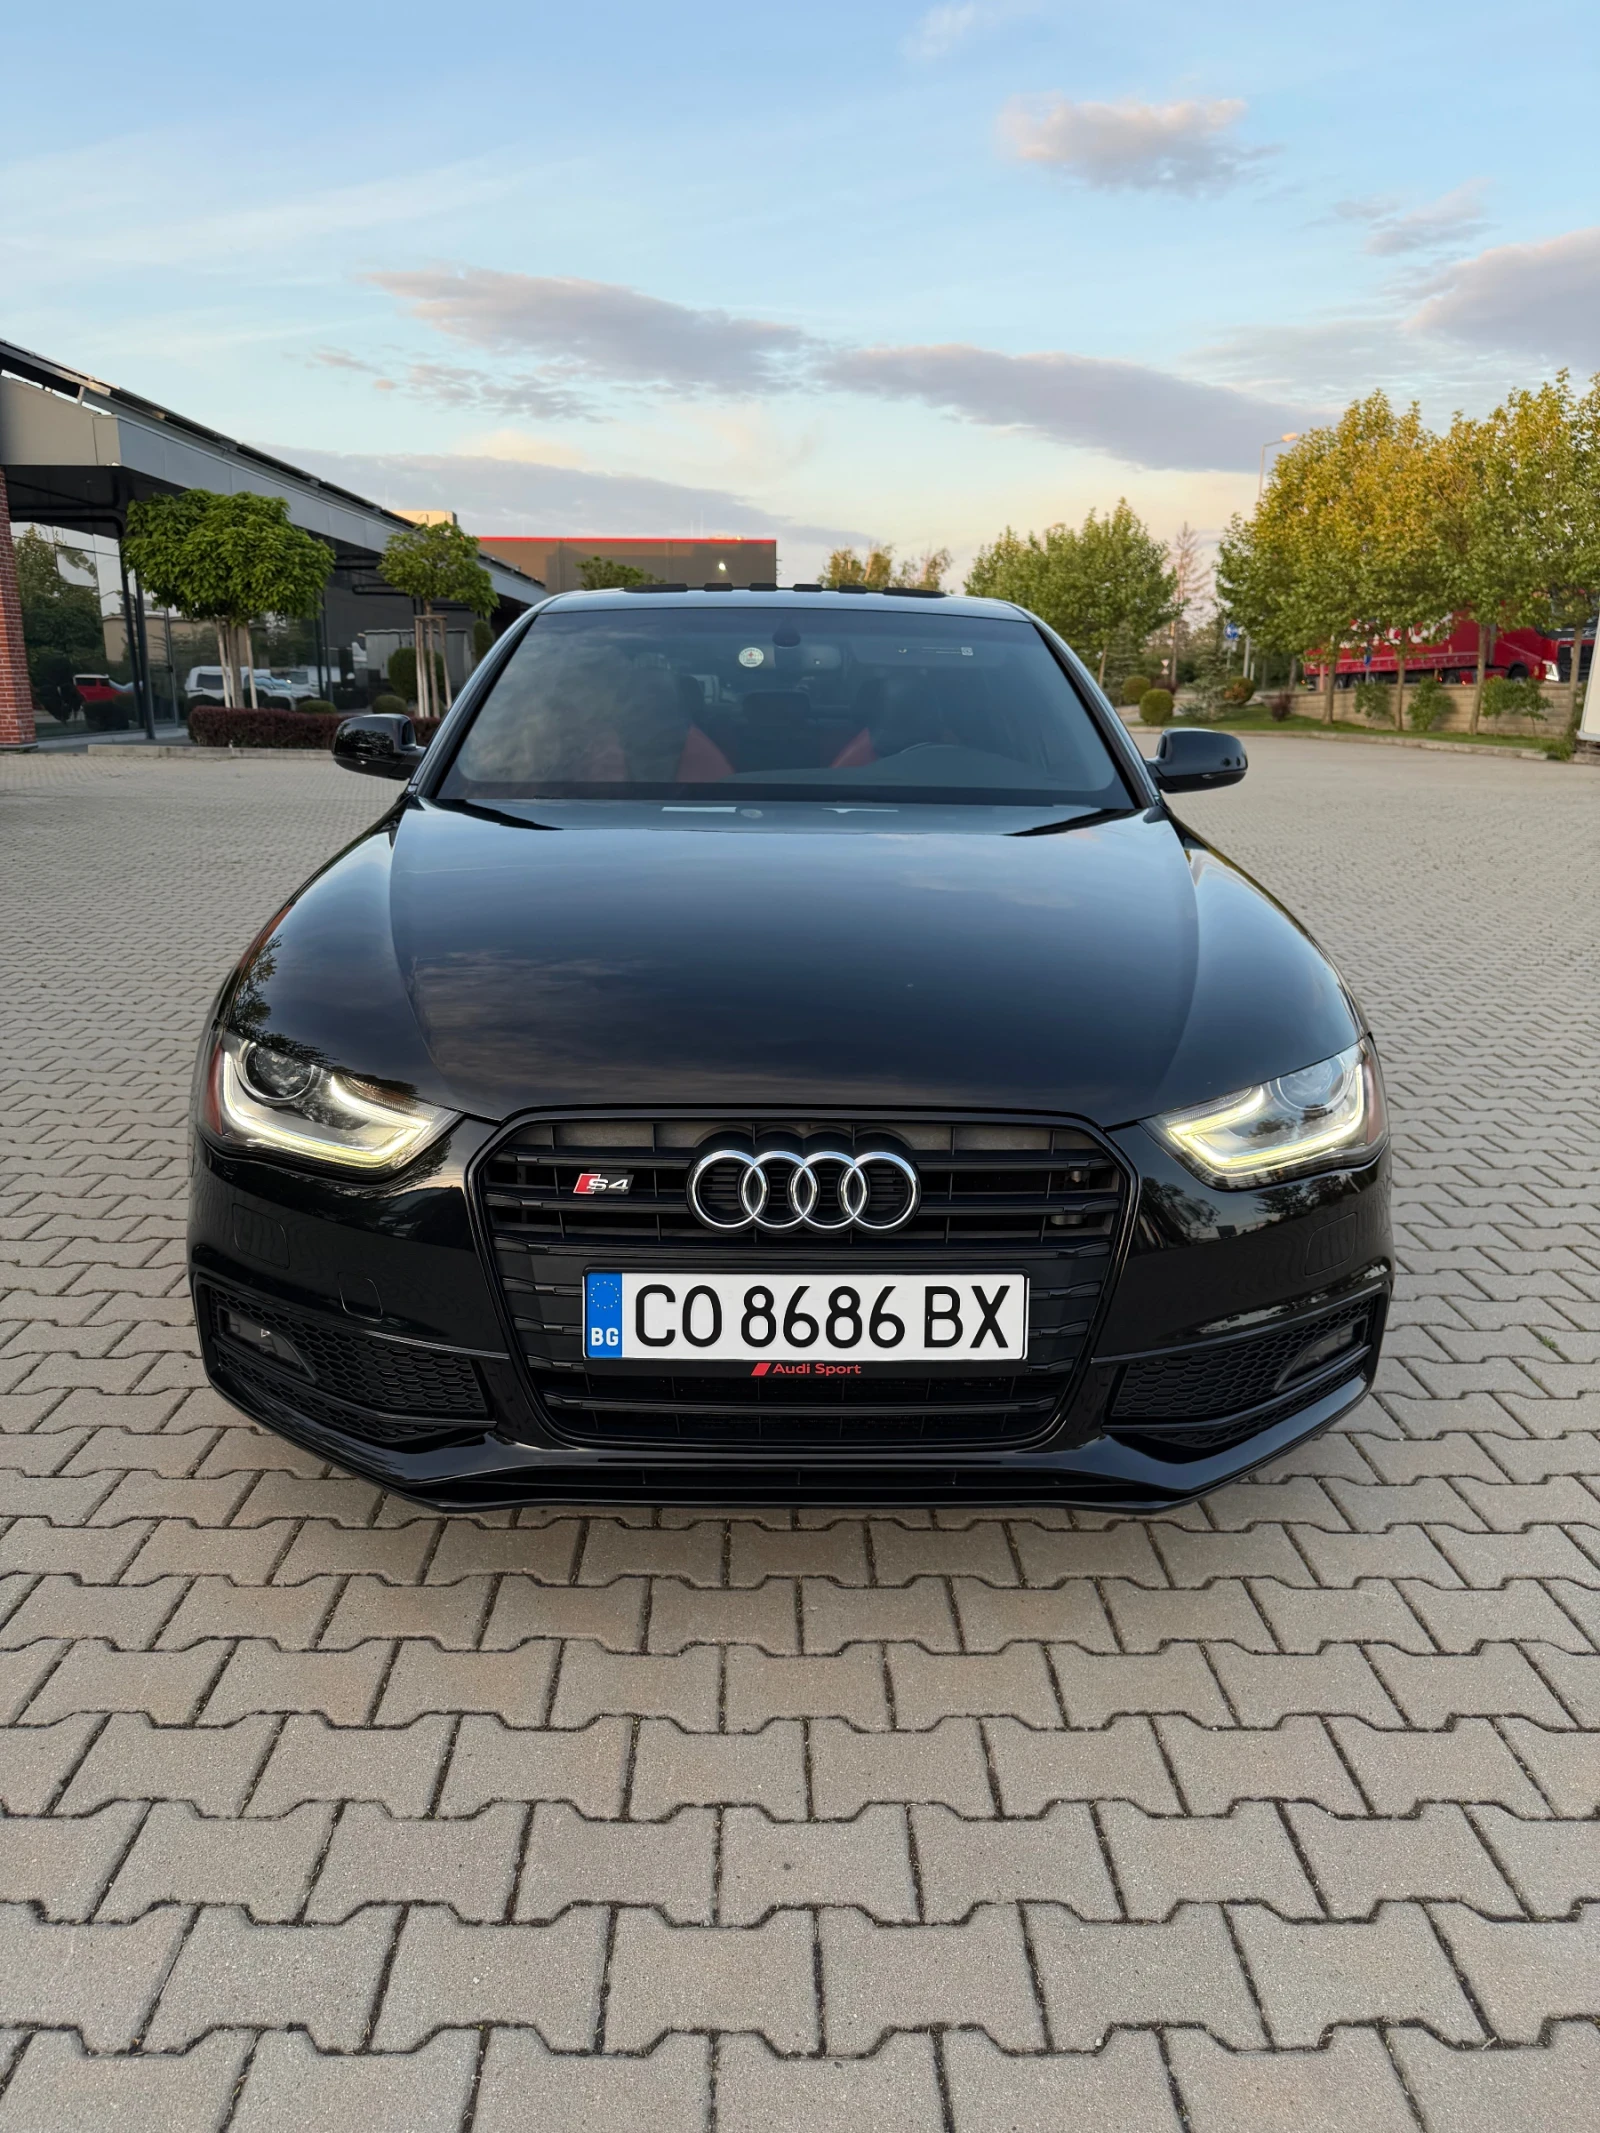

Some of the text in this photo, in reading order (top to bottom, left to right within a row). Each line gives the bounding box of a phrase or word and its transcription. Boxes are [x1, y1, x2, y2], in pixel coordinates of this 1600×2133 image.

[586, 1178, 629, 1192] S4
[635, 1284, 1010, 1348] CO 8686 BX
[591, 1327, 619, 1346] BG
[772, 1363, 861, 1376] Audi Sport
